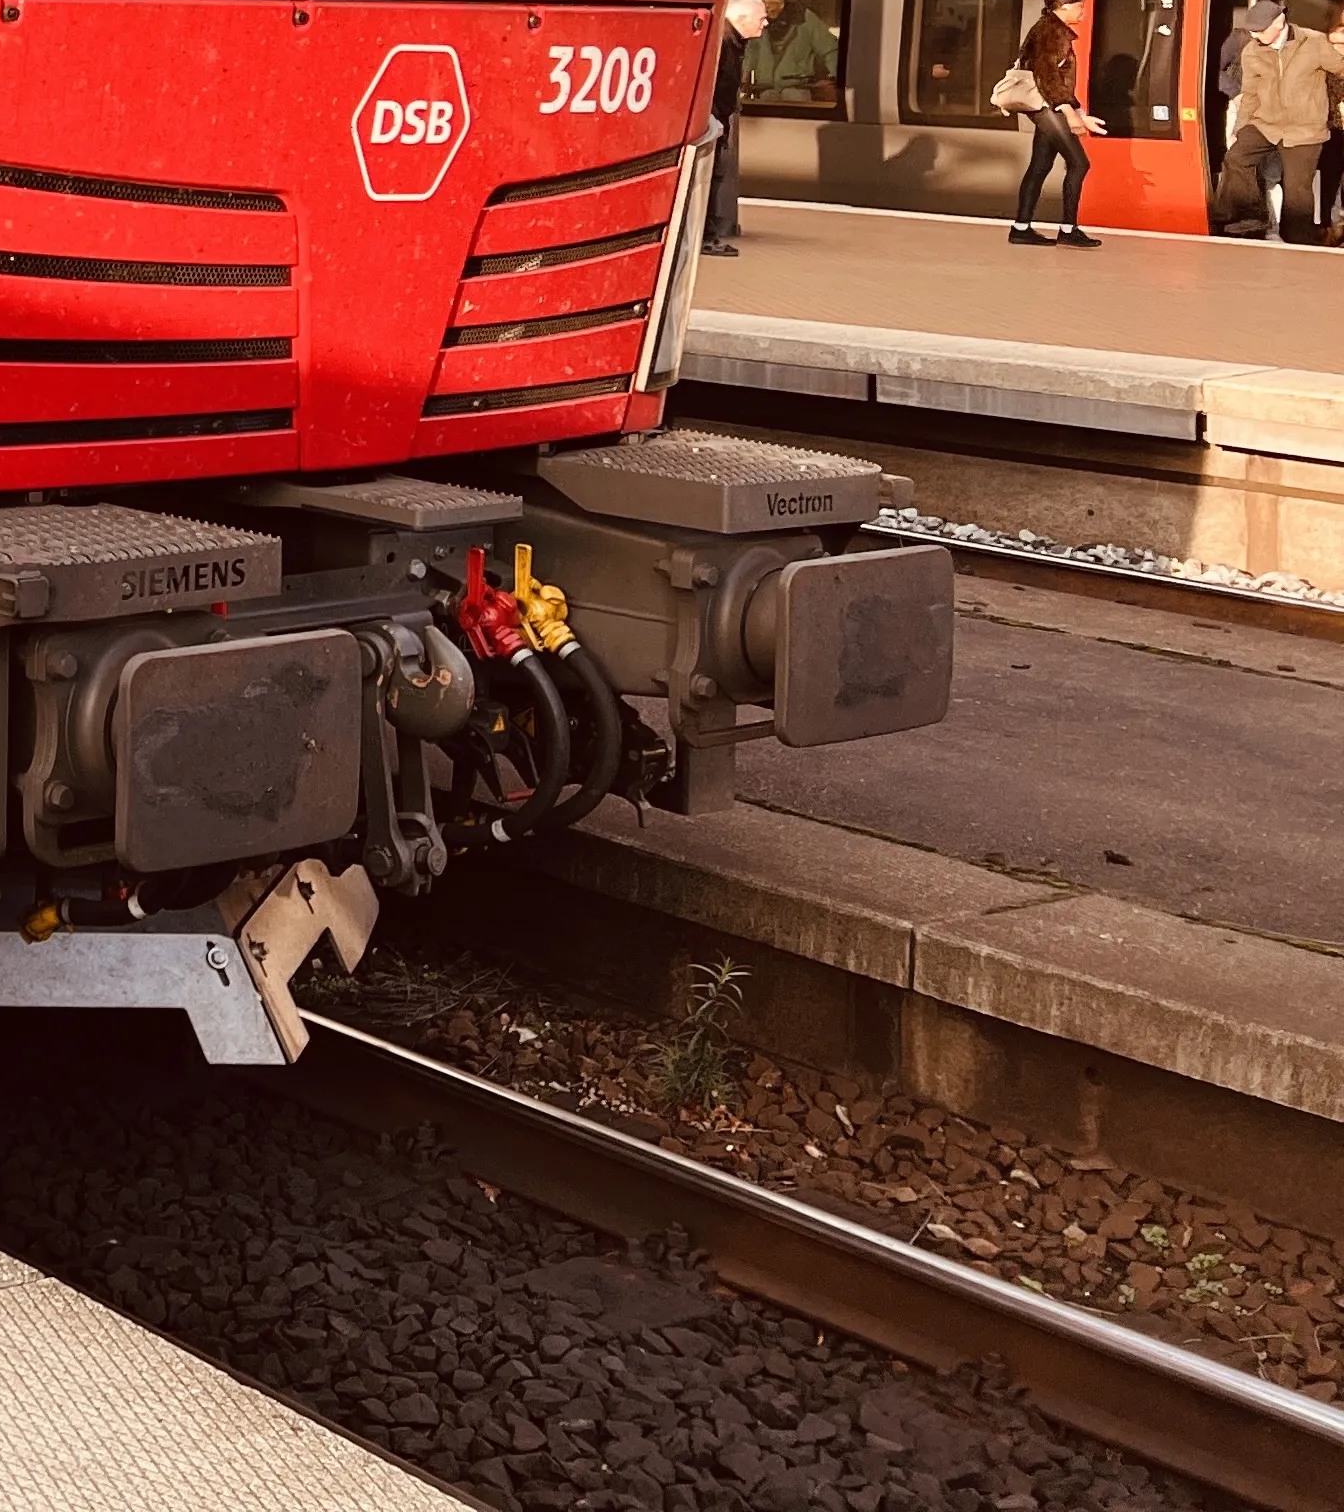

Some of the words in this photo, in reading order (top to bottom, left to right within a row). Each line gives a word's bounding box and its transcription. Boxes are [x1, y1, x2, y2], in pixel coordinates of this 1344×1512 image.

[539, 45, 657, 114] 3208
[369, 99, 453, 145] DSB
[766, 490, 834, 517] Vectron
[120, 557, 247, 601] SIEMENS
